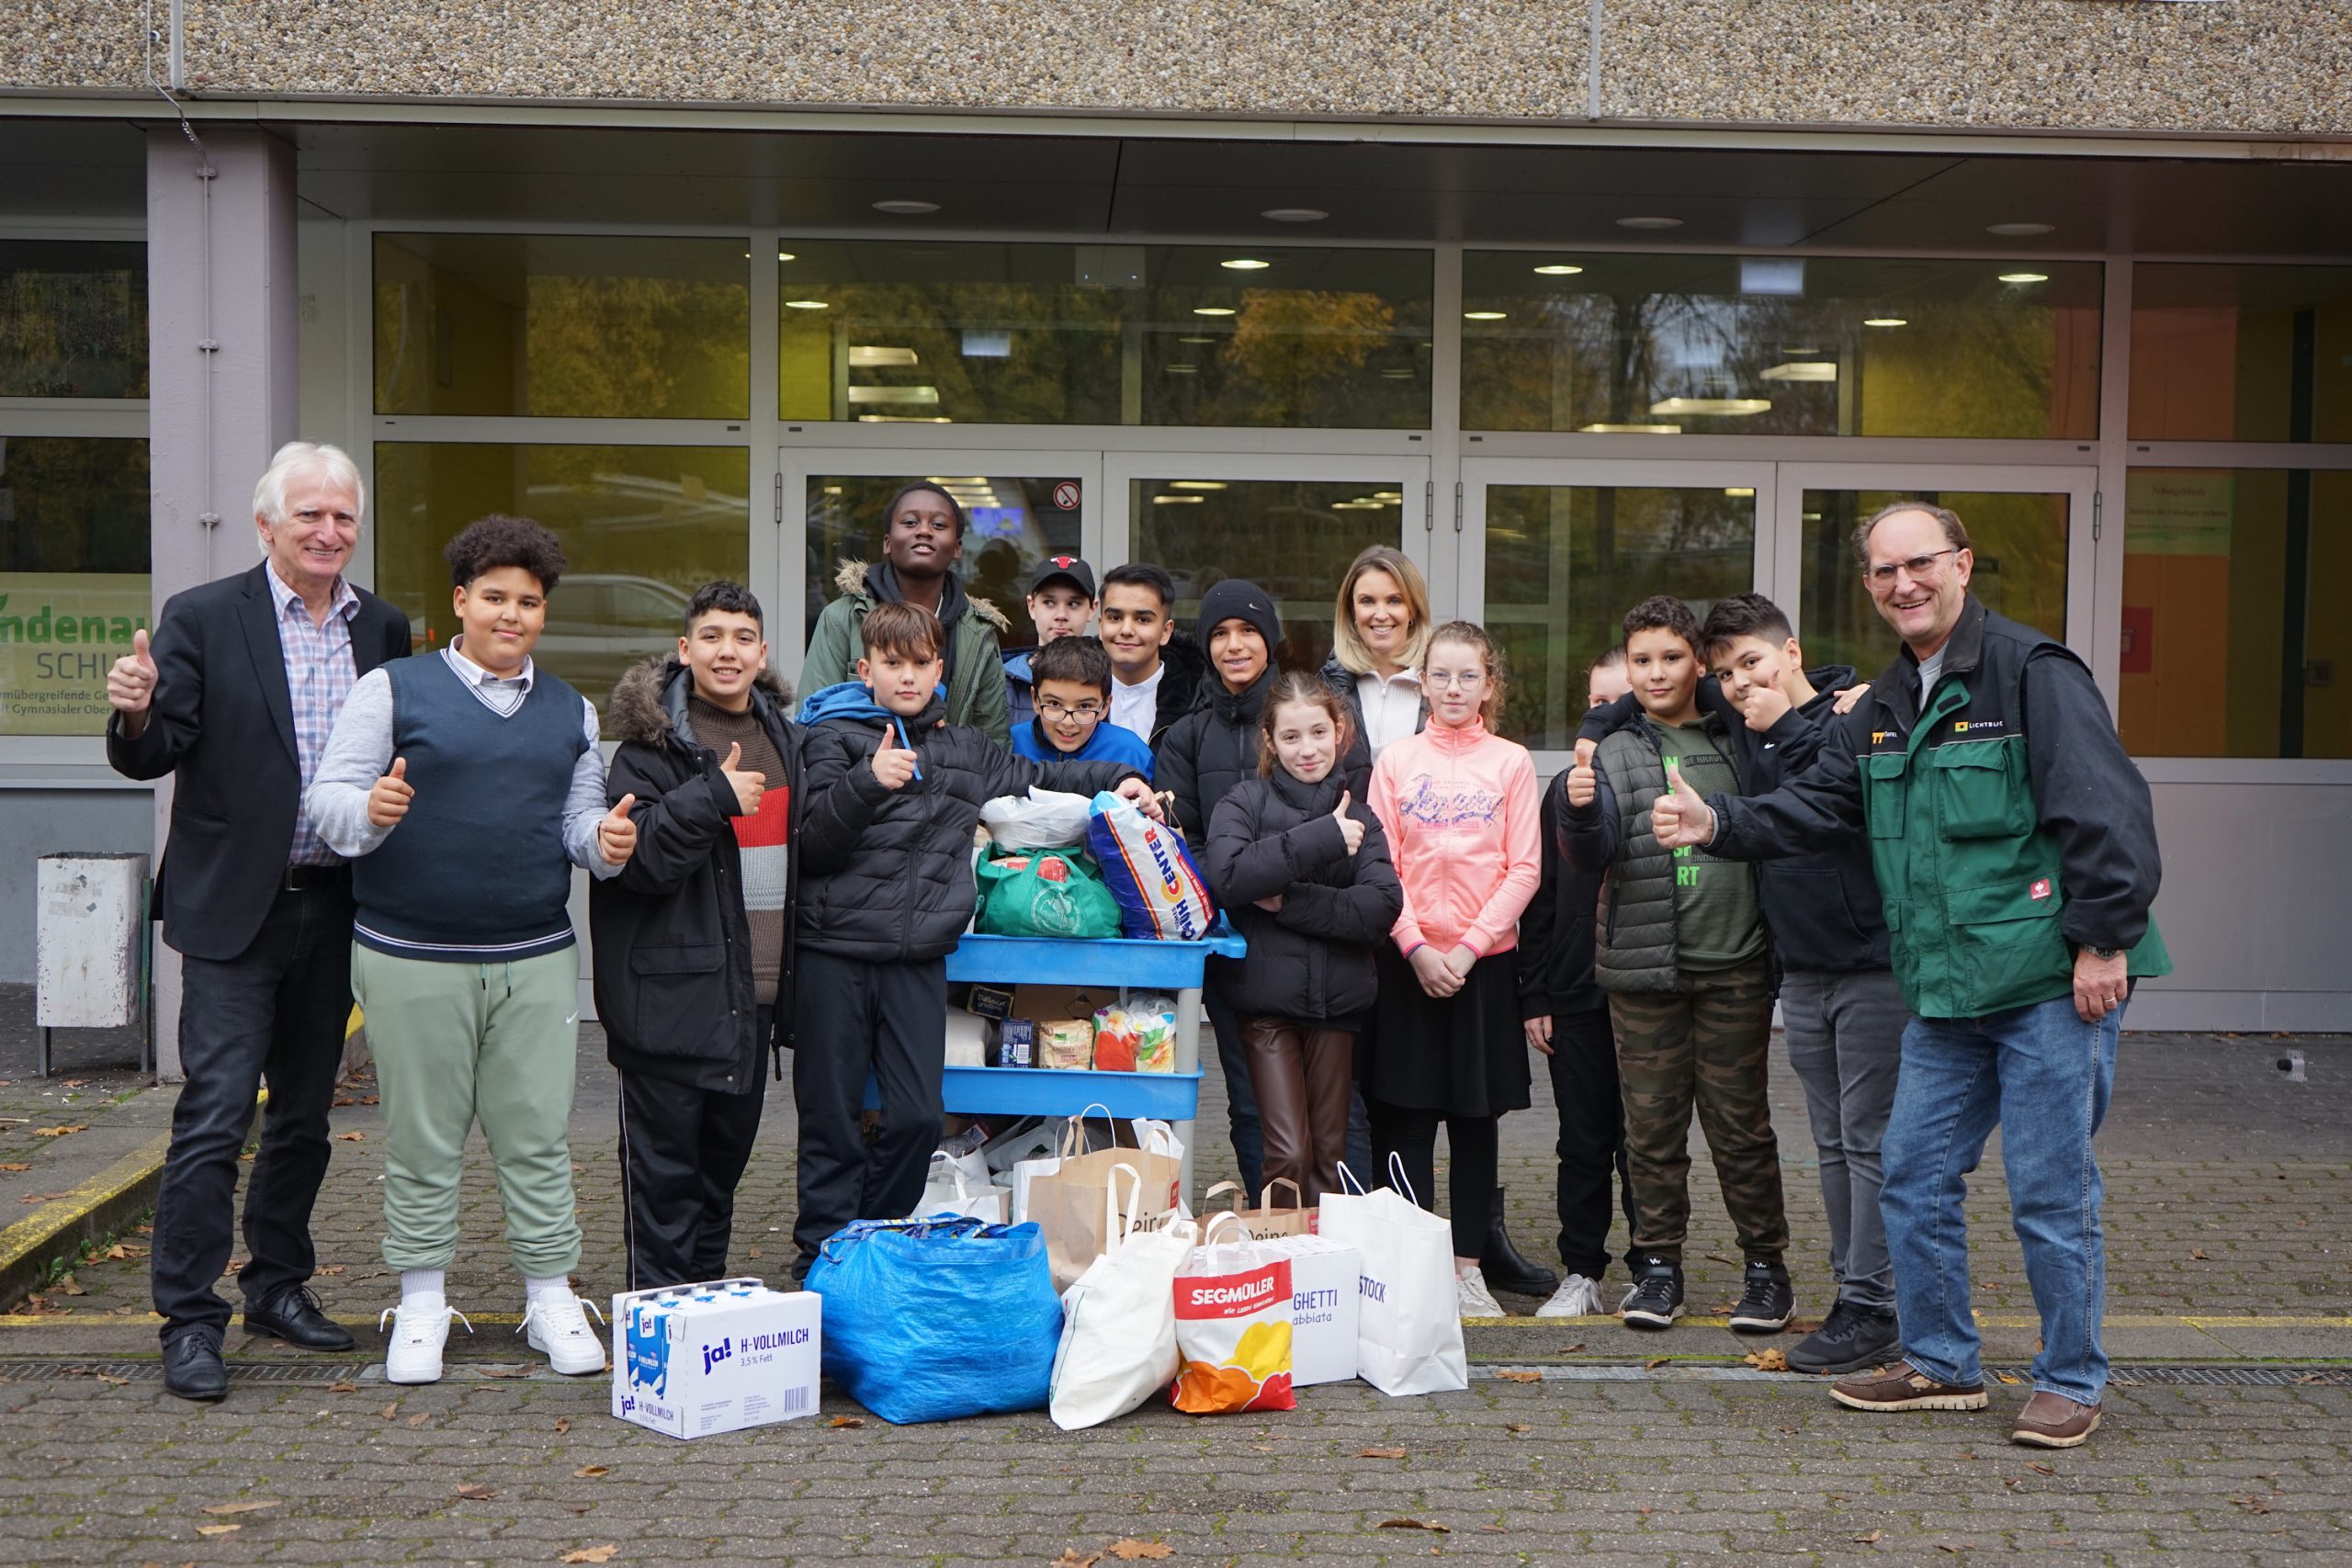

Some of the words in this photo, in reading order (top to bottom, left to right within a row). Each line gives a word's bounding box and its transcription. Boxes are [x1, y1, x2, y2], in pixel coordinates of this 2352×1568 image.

[37, 652, 130, 680] SCHU
[12, 704, 81, 716] Gymnasialer
[1684, 757, 1695, 766] BE
[1697, 755, 1725, 764] BRAVE
[1144, 826, 1181, 897] CENTER
[1191, 1276, 1275, 1306] SEGMÜLLER
[1293, 1289, 1338, 1311] GHETTI
[741, 1327, 809, 1353] H-VOLLMILCH
[702, 1337, 732, 1376] ja!
[759, 1354, 774, 1364] Fett
[620, 1394, 636, 1416] ja!
[639, 1400, 674, 1422] H-VOLLMILCH
